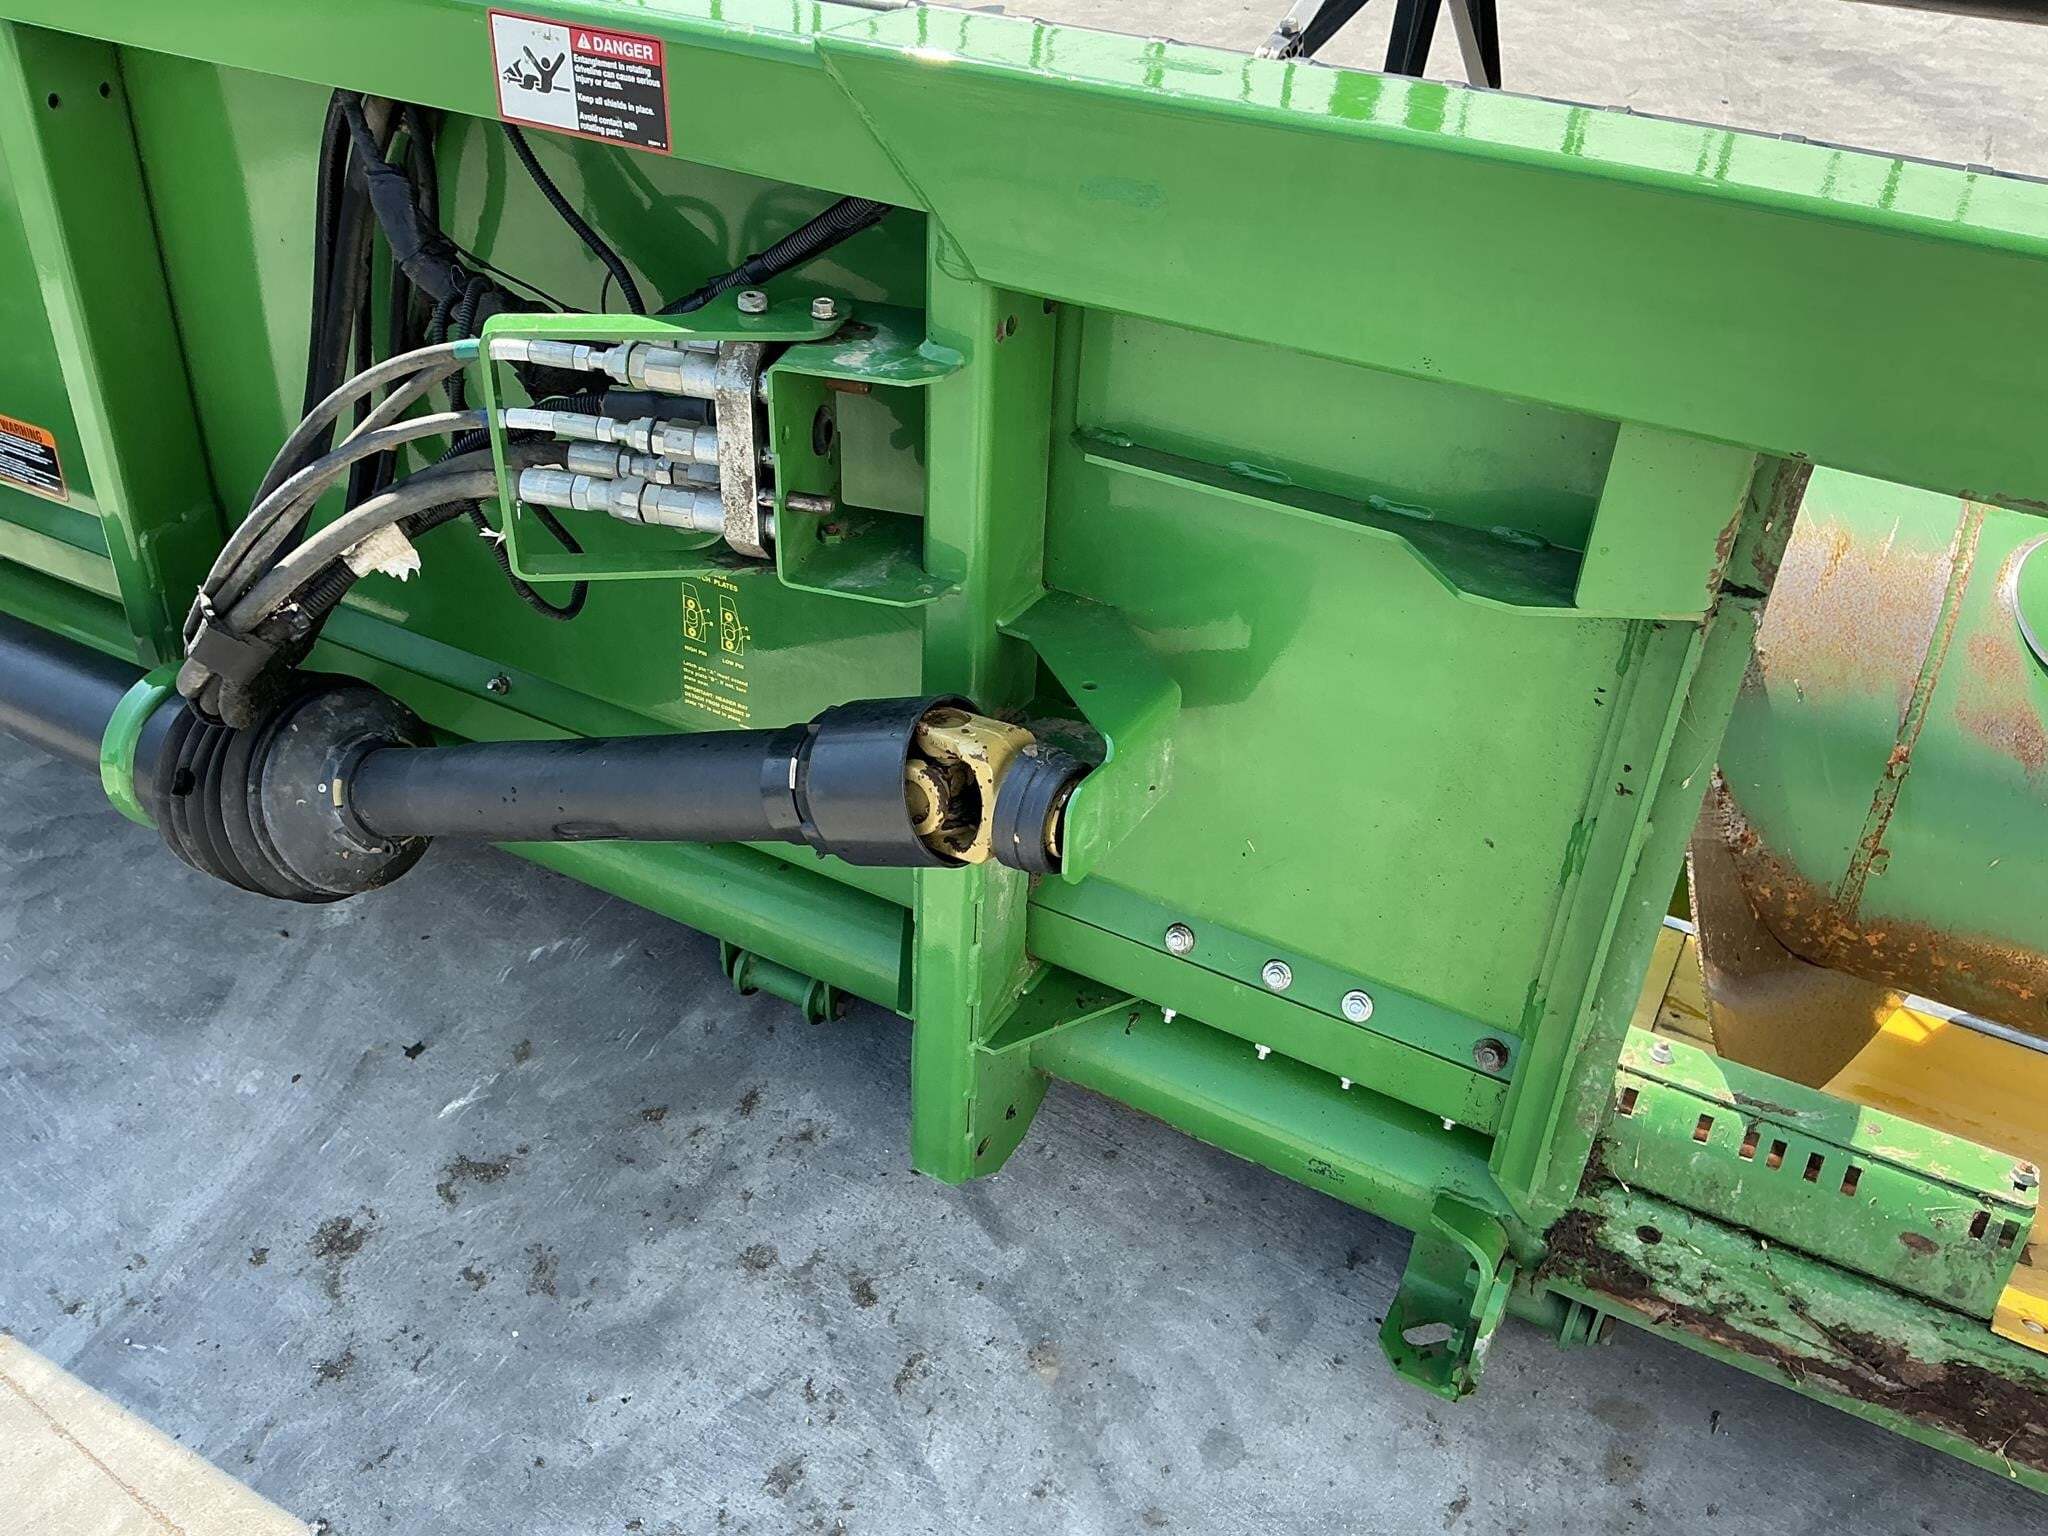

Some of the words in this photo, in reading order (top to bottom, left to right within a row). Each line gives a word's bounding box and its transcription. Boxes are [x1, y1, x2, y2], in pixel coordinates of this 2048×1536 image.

[593, 36, 653, 60] DANGER
[573, 53, 618, 69] Entanglement
[618, 62, 625, 71] in
[625, 64, 651, 78] rotating
[574, 64, 602, 77] driveline
[602, 71, 615, 79] can
[616, 73, 636, 83] cause
[636, 76, 661, 88] serious
[575, 73, 594, 87] injury
[594, 78, 602, 86] or
[603, 79, 623, 90] death.
[577, 92, 595, 105] Keep
[595, 96, 603, 105] all
[604, 98, 627, 111] shields
[628, 102, 635, 111] in
[635, 104, 656, 116] place.
[580, 112, 598, 123] Avoid
[598, 116, 623, 128] contact
[623, 121, 638, 131] with
[580, 123, 605, 135] rotating
[605, 127, 625, 138] parts.
[0, 419, 43, 443] WARNING
[713, 578, 738, 592] PLATES
[684, 645, 697, 653] HIGH
[698, 649, 708, 657] PIN
[722, 658, 734, 666] LOW
